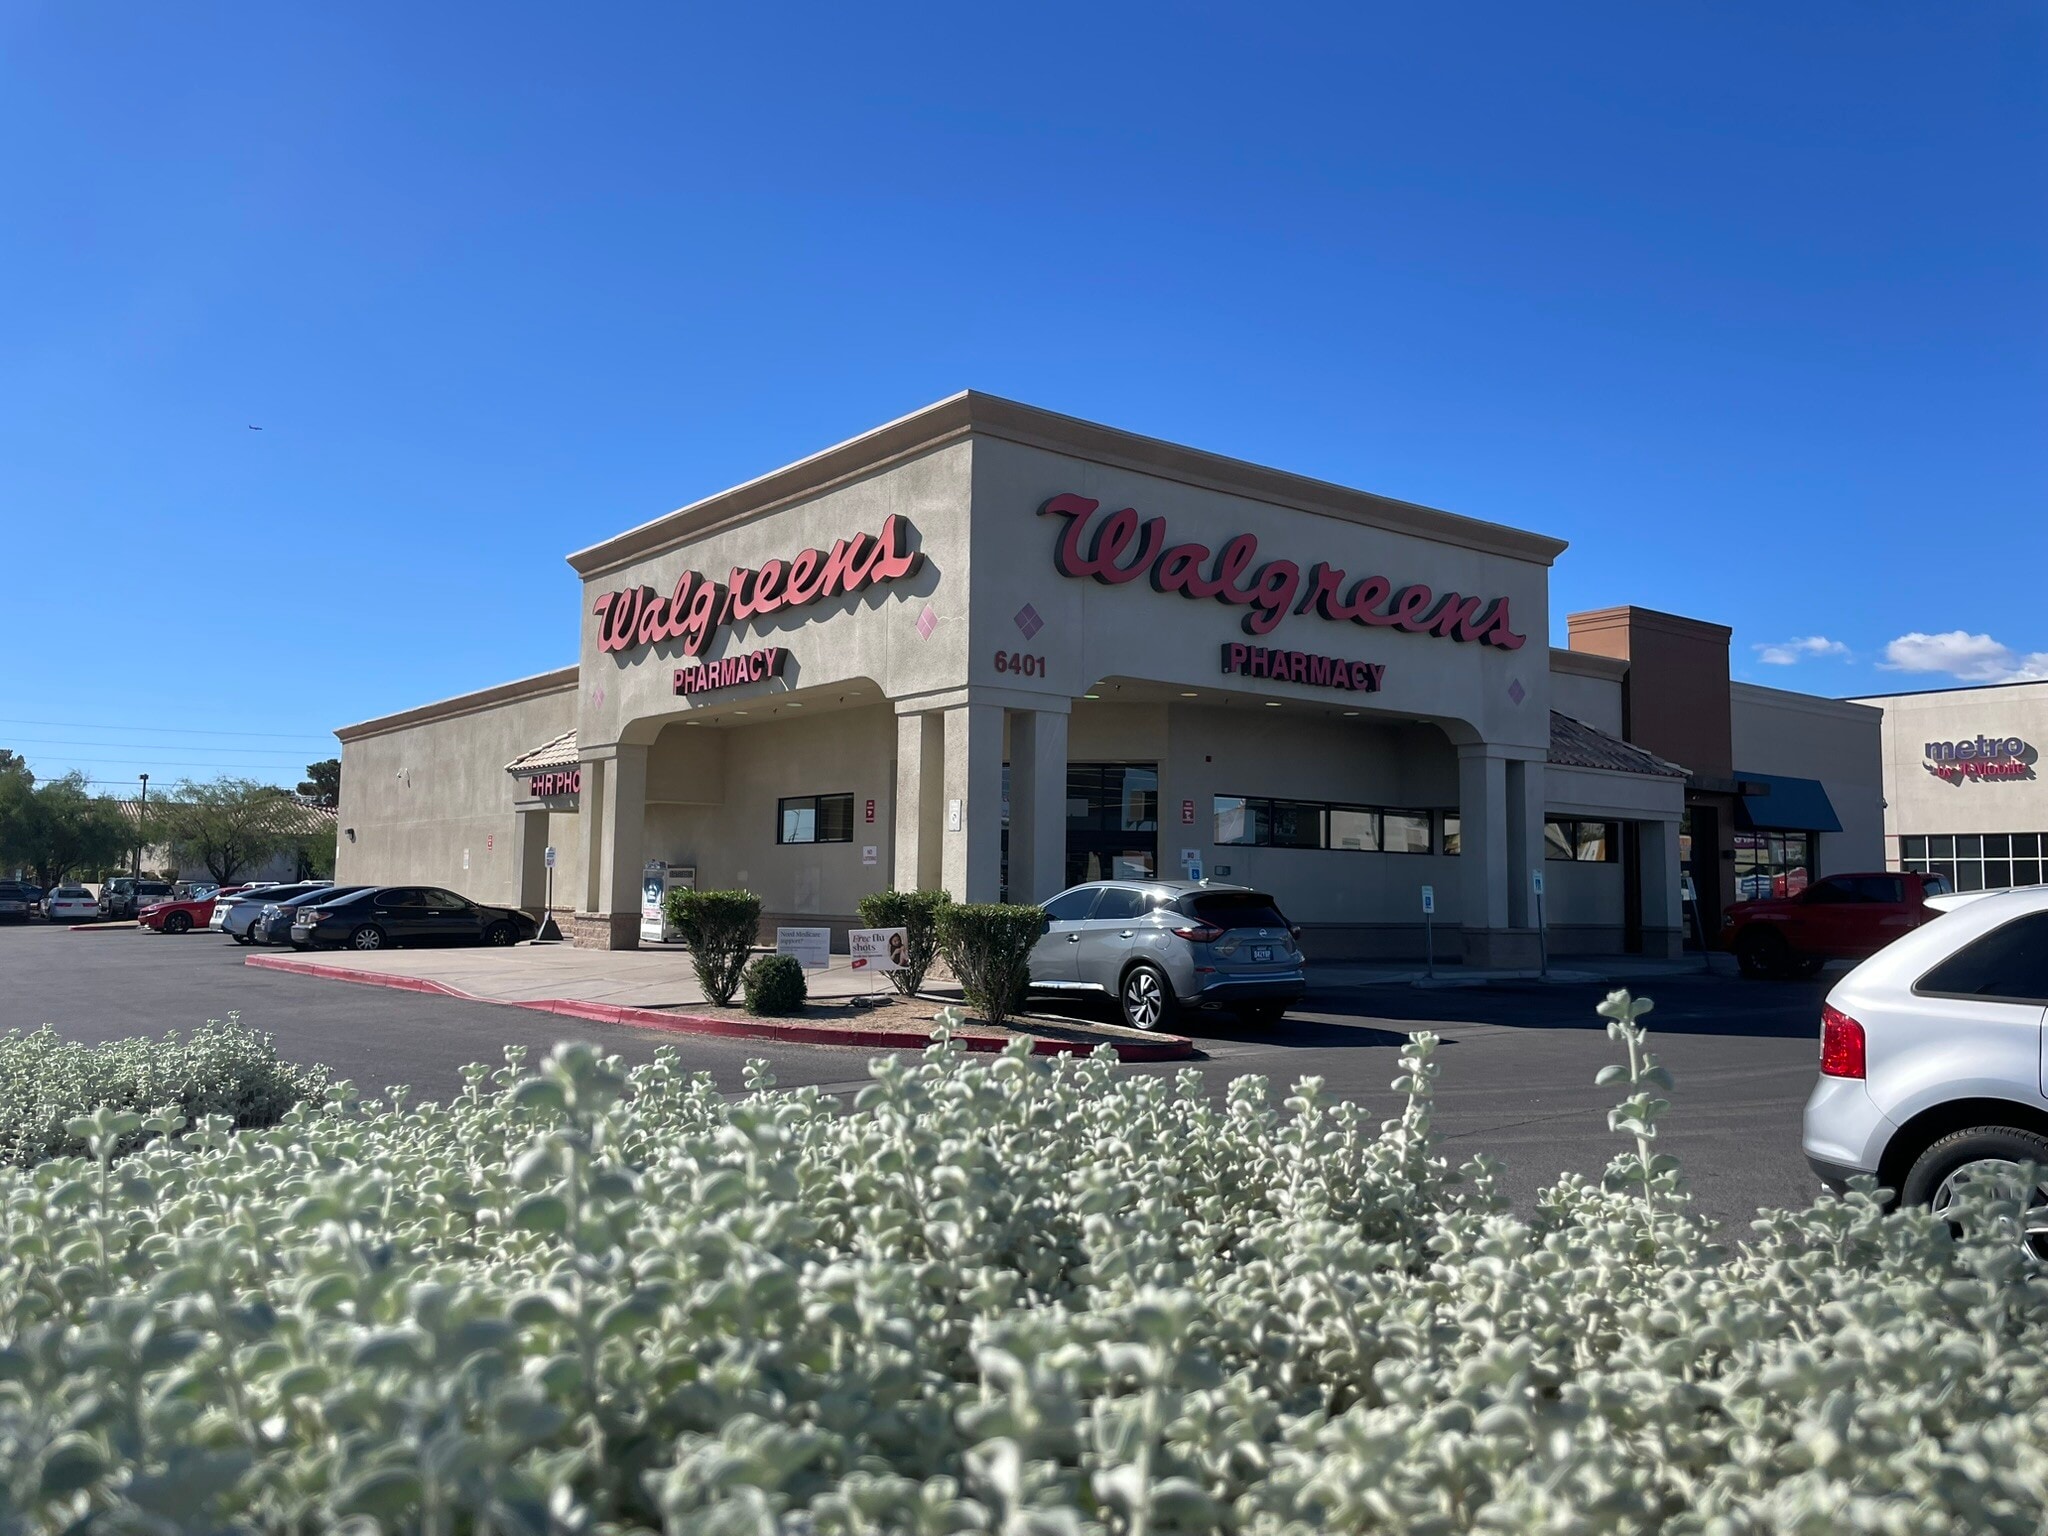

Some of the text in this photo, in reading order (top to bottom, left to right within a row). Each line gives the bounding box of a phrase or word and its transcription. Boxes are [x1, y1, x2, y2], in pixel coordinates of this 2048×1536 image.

[593, 513, 922, 658] Walgreens
[1037, 492, 1526, 650] Walgreens
[673, 647, 784, 696] PHARMACY
[993, 650, 1047, 679] 6401
[1224, 643, 1386, 693] PHARMACY
[1924, 734, 2026, 761] metro
[1960, 760, 2027, 776] T-Mobile
[852, 933, 885, 943] Free flu
[852, 943, 877, 952] shots
